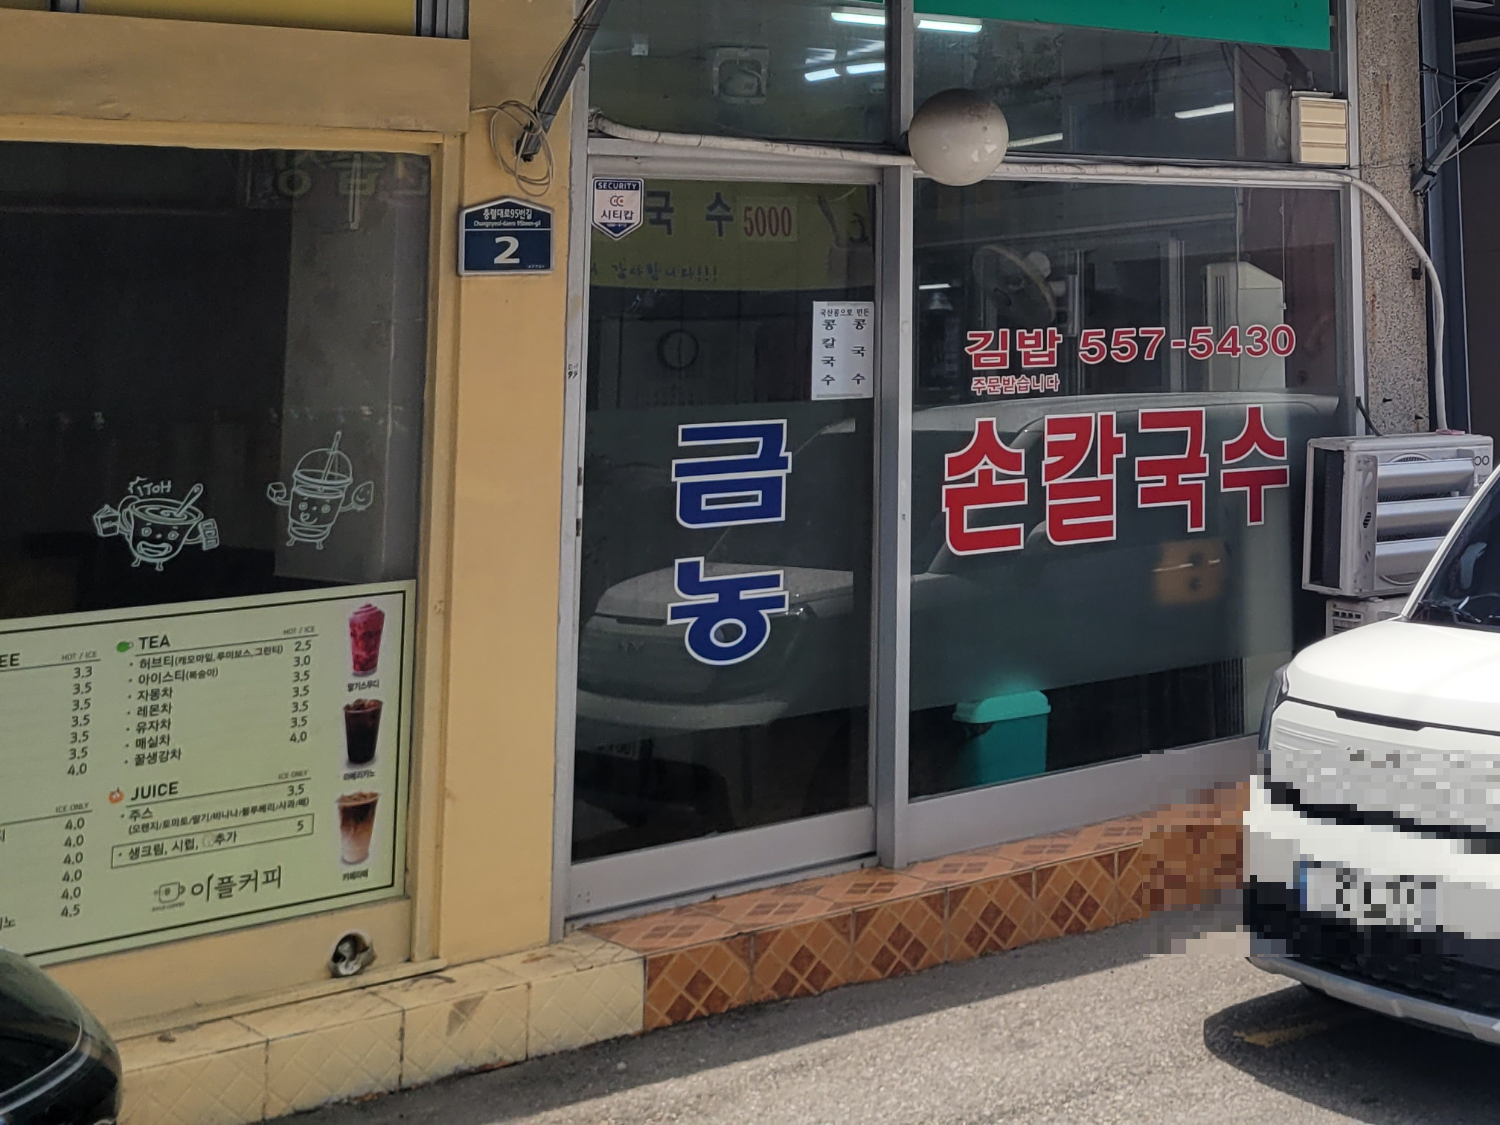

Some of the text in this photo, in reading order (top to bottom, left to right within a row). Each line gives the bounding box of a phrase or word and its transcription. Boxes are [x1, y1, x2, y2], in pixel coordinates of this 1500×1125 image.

[597, 181, 638, 190] SECURITY
[600, 208, 635, 221] 시티캅
[743, 204, 793, 238] 5000
[493, 236, 521, 265] 2
[850, 317, 868, 386] 콩국수
[964, 323, 1297, 371] 김밥 557-5430
[969, 373, 1061, 396] 주문받습니다
[941, 403, 1291, 557] 손칼국수
[666, 417, 793, 667] 금농
[138, 634, 171, 650] TEA
[294, 639, 312, 653] 2.5
[293, 654, 311, 667] 3.0
[73, 666, 93, 679] 3.3
[292, 669, 310, 683] 3.5
[72, 682, 92, 695] 3.5
[137, 686, 173, 702] 자몽차
[292, 685, 310, 698] 3.5
[71, 698, 91, 711] 3.5
[136, 702, 173, 718] 레몬차
[291, 700, 309, 713] 3.5
[71, 714, 91, 727] 3.5
[135, 717, 172, 735] 유자차
[290, 716, 308, 729] 3.5
[69, 730, 89, 744] 3.5
[135, 733, 171, 750] 매실차
[289, 731, 308, 744] 4.0
[68, 746, 88, 760] 3.5
[67, 763, 87, 776] 4.0
[130, 780, 179, 801] JUICE
[287, 783, 305, 797] 3.5
[128, 807, 153, 822] 주스
[64, 816, 85, 830] 4.0
[63, 834, 84, 848] 4.0
[62, 851, 83, 865] 4.0
[62, 868, 82, 883] 4.0
[190, 864, 283, 902] 이플커피
[61, 886, 81, 900] 4.0
[60, 903, 80, 917] 4.5
